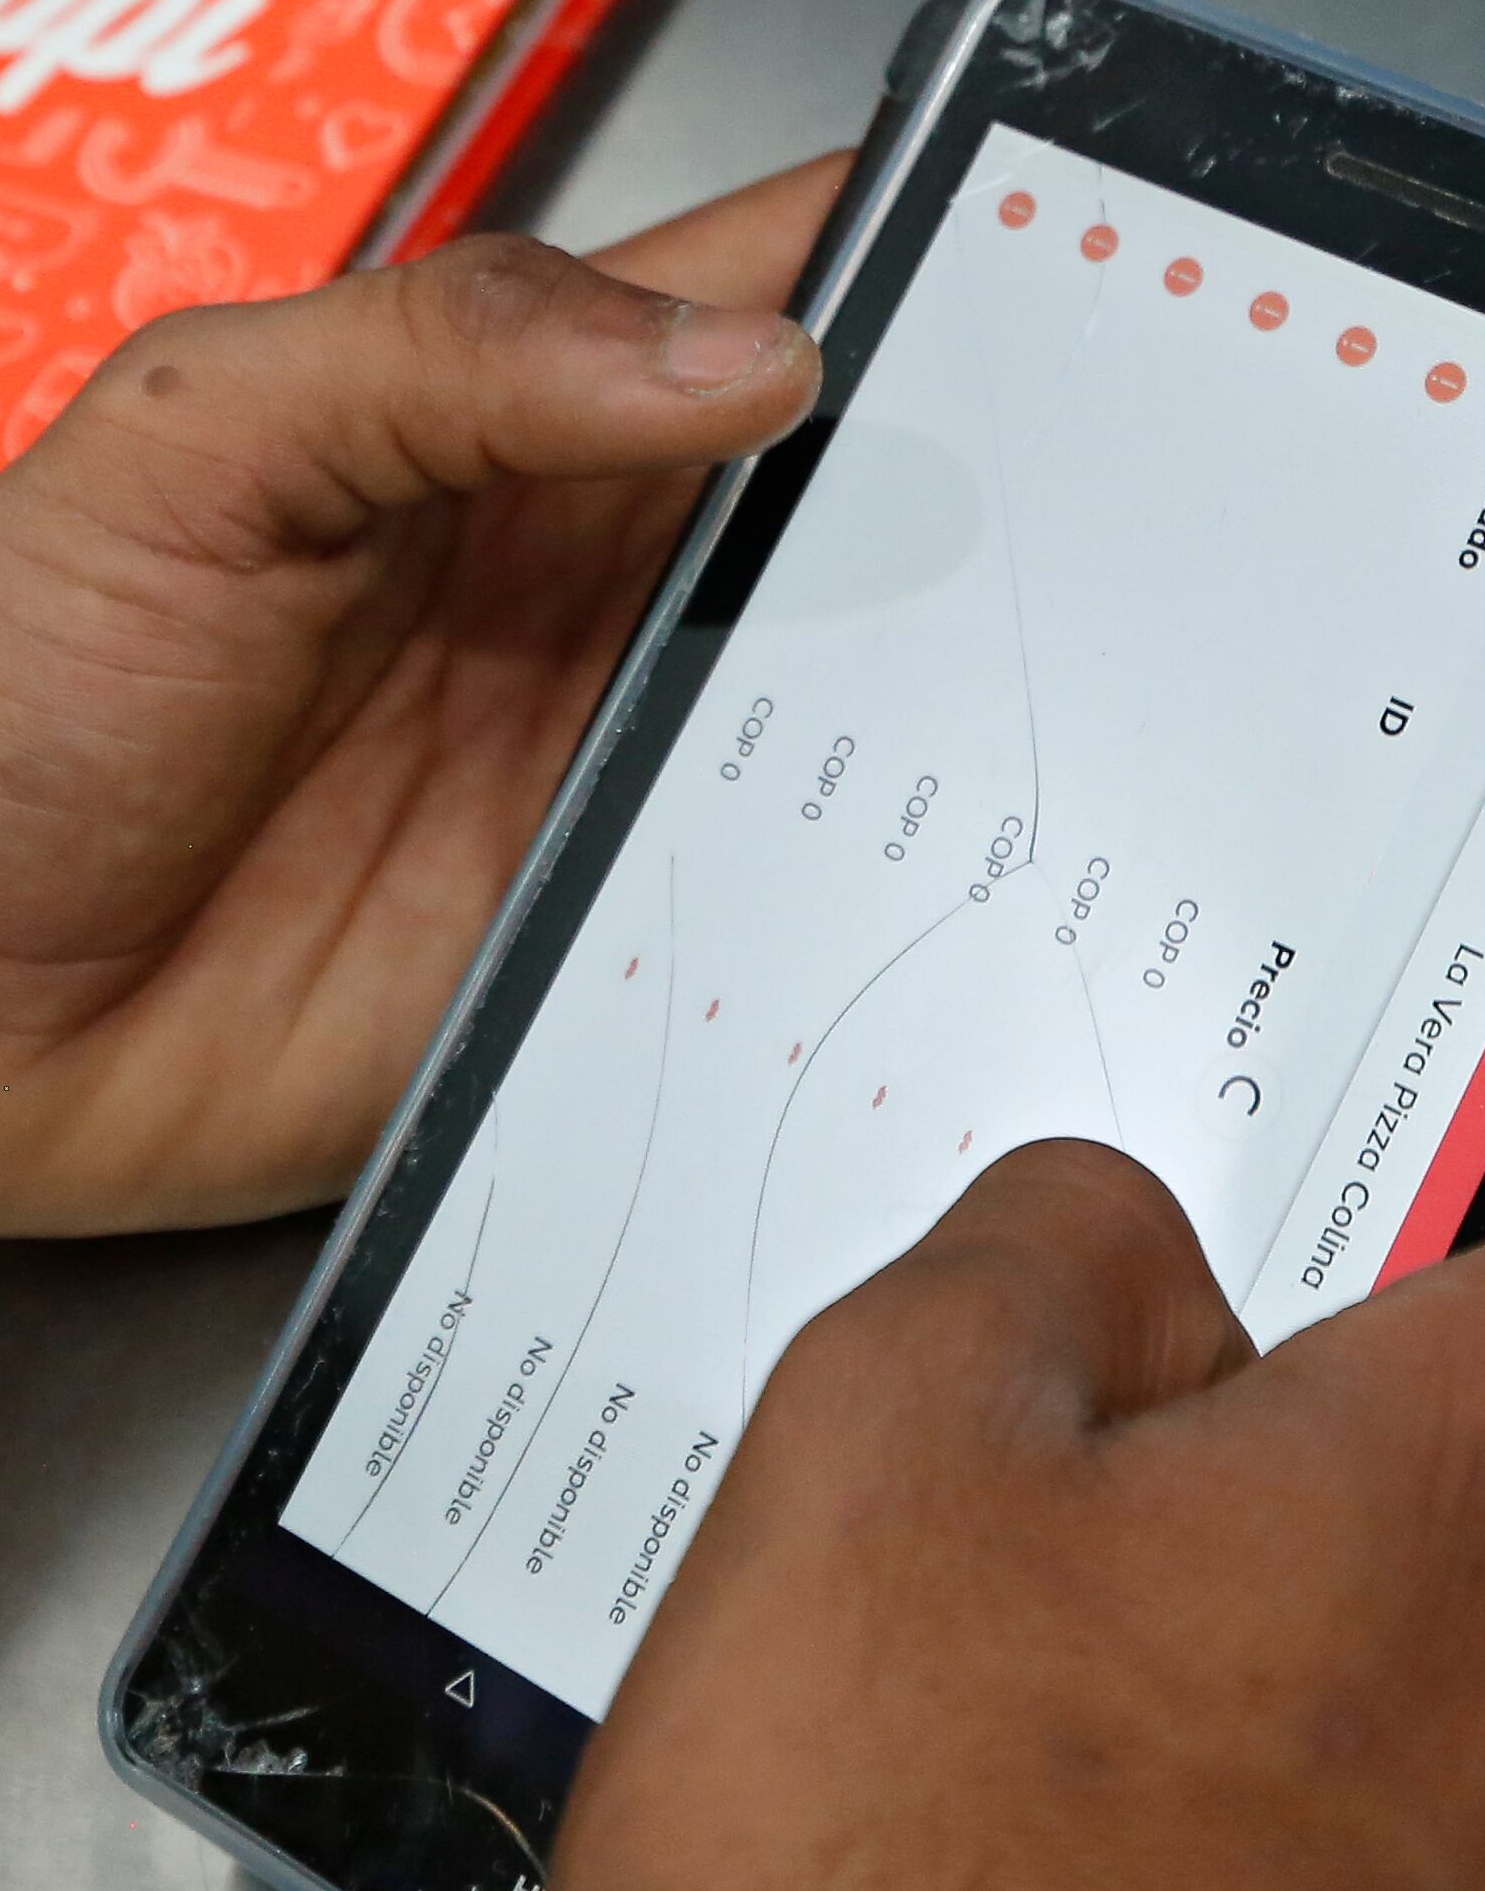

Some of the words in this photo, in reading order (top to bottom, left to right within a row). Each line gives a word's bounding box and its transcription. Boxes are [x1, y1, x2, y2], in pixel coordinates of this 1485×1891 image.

[735, 697, 774, 758] COP
[1379, 695, 1415, 737] ID
[817, 735, 856, 798] COP
[899, 775, 939, 838] COP
[984, 815, 1024, 878] COP
[1070, 856, 1111, 921] COP
[1159, 898, 1199, 964] COP
[1226, 939, 1296, 1048] Precio
[1445, 943, 1485, 987] La
[1402, 999, 1463, 1076] Vera
[1357, 1081, 1419, 1172] Pizza
[1300, 1181, 1370, 1290] Colina
[439, 1290, 474, 1331] No
[519, 1336, 554, 1377] No
[365, 1336, 446, 1478] disponible
[601, 1382, 636, 1424] No
[444, 1382, 525, 1525] disponible
[684, 1430, 719, 1473] No
[525, 1430, 607, 1575] disponible
[608, 1478, 690, 1625] disponible
